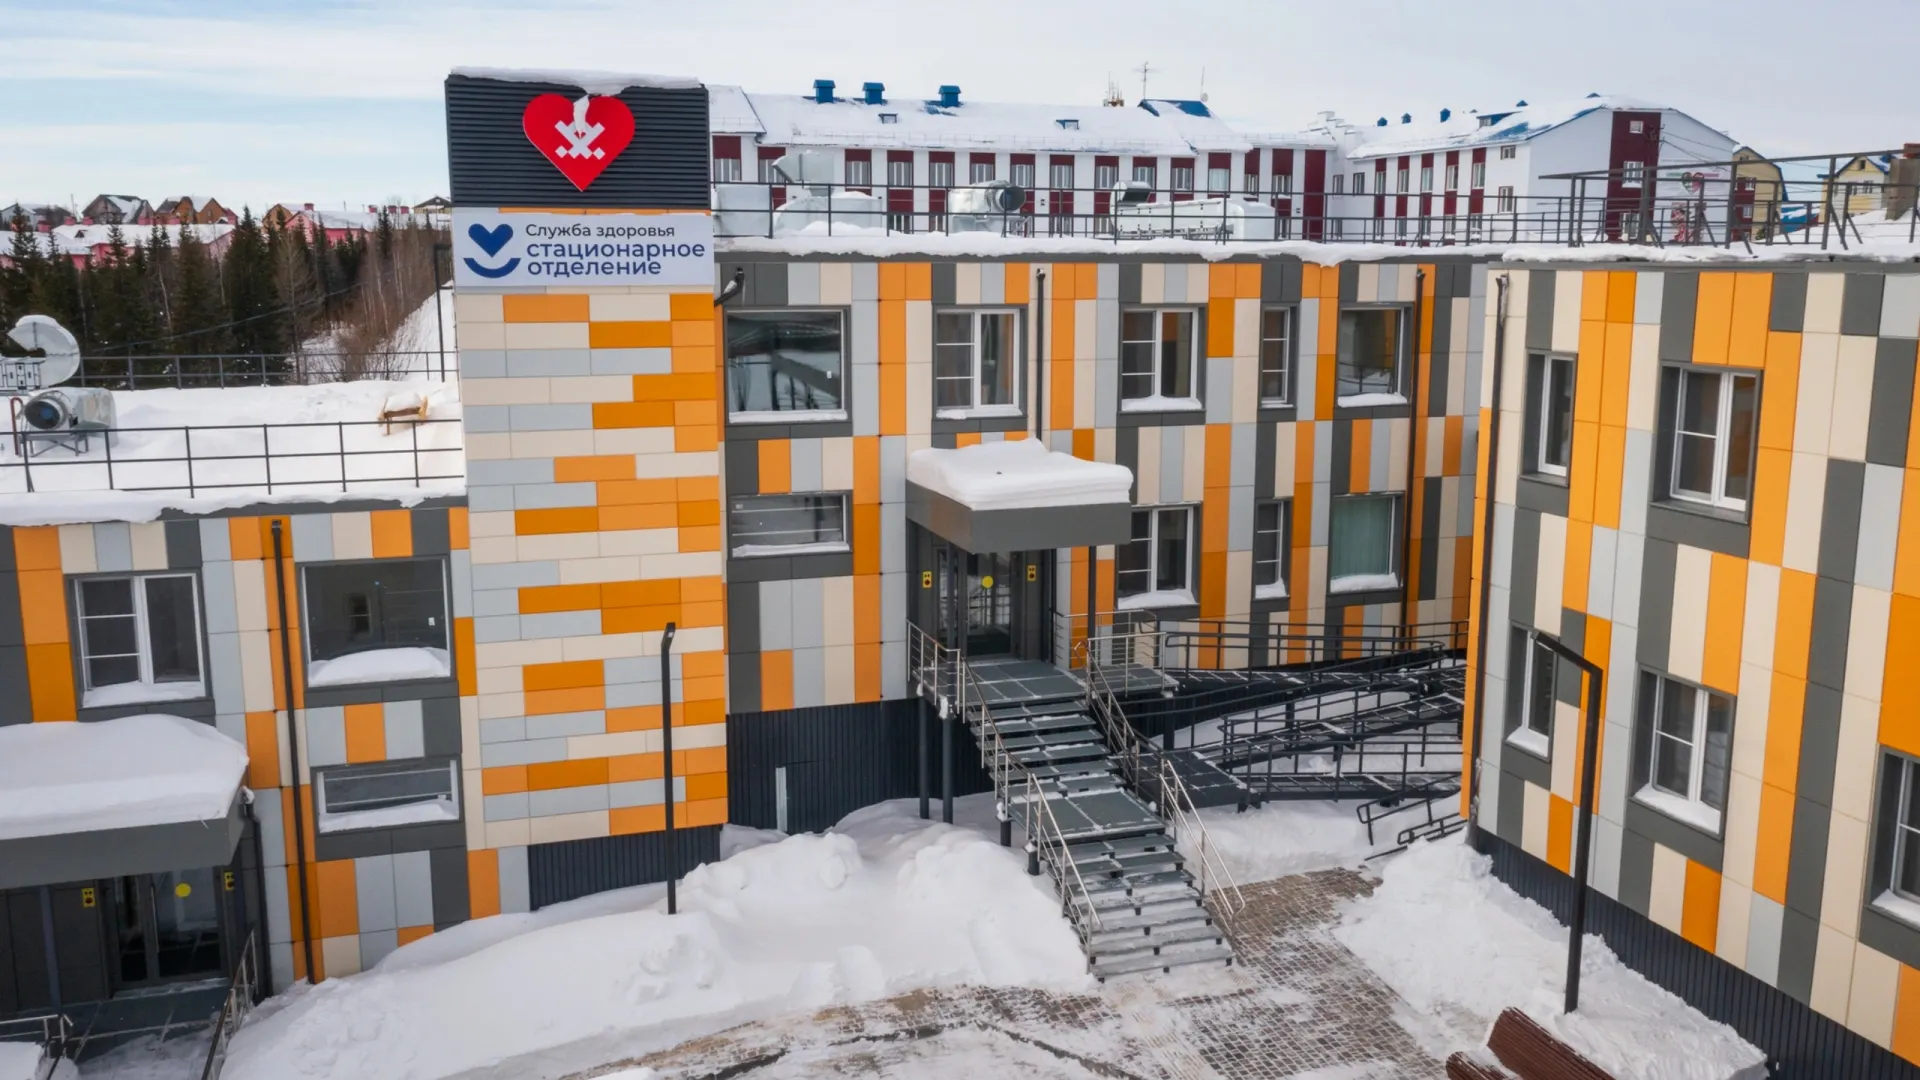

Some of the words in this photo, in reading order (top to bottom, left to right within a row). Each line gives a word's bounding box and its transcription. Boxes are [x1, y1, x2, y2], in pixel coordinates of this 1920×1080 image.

[526, 223, 591, 239] Служба
[596, 226, 675, 239] здоровья
[527, 243, 705, 261] стационарное
[528, 261, 661, 277] отделение
